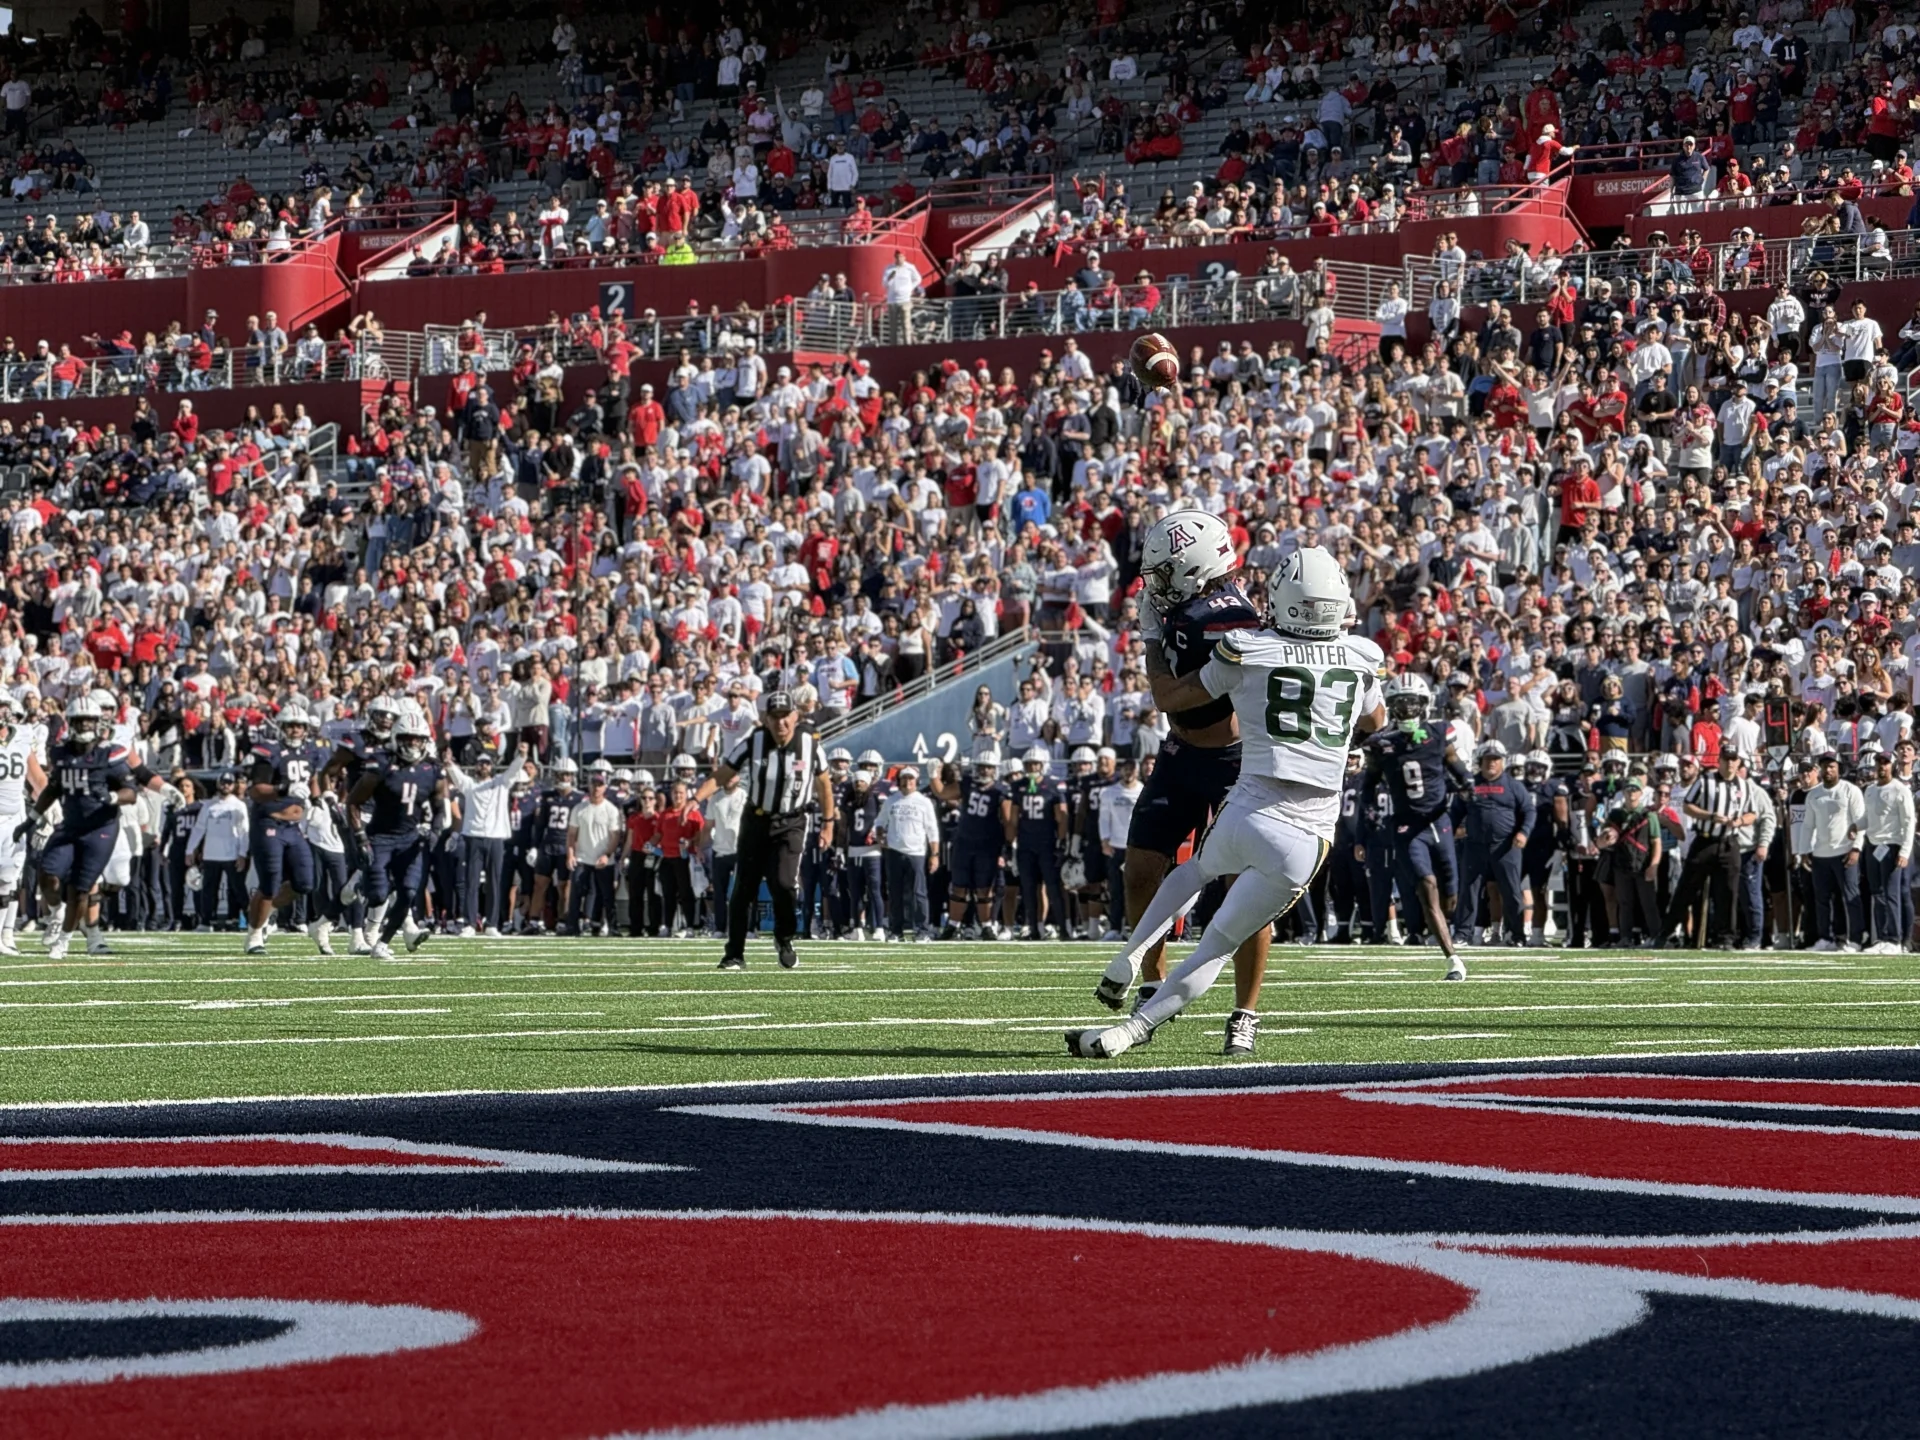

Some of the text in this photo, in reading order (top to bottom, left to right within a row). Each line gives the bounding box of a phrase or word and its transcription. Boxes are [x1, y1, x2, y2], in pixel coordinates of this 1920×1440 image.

[1784, 45, 1797, 60] 11
[305, 174, 317, 187] 23
[1605, 182, 1619, 193] 104
[607, 285, 625, 315] 2
[1167, 524, 1197, 554] A
[1208, 595, 1242, 609] 43
[1176, 630, 1188, 650] C
[1292, 626, 1333, 637] Riddell
[1283, 645, 1347, 666] PORTER
[1265, 666, 1358, 747] 83
[1766, 703, 1789, 743] 4
[0, 752, 24, 780] 66
[287, 760, 311, 786] 95
[61, 768, 90, 796] 44
[1403, 761, 1424, 799] 9
[401, 782, 417, 815] 4
[967, 791, 991, 816] 56
[1022, 795, 1045, 819] 42
[1377, 793, 1394, 816] 91
[175, 815, 196, 837] 24
[549, 805, 569, 829] 23
[854, 808, 866, 831] 6
